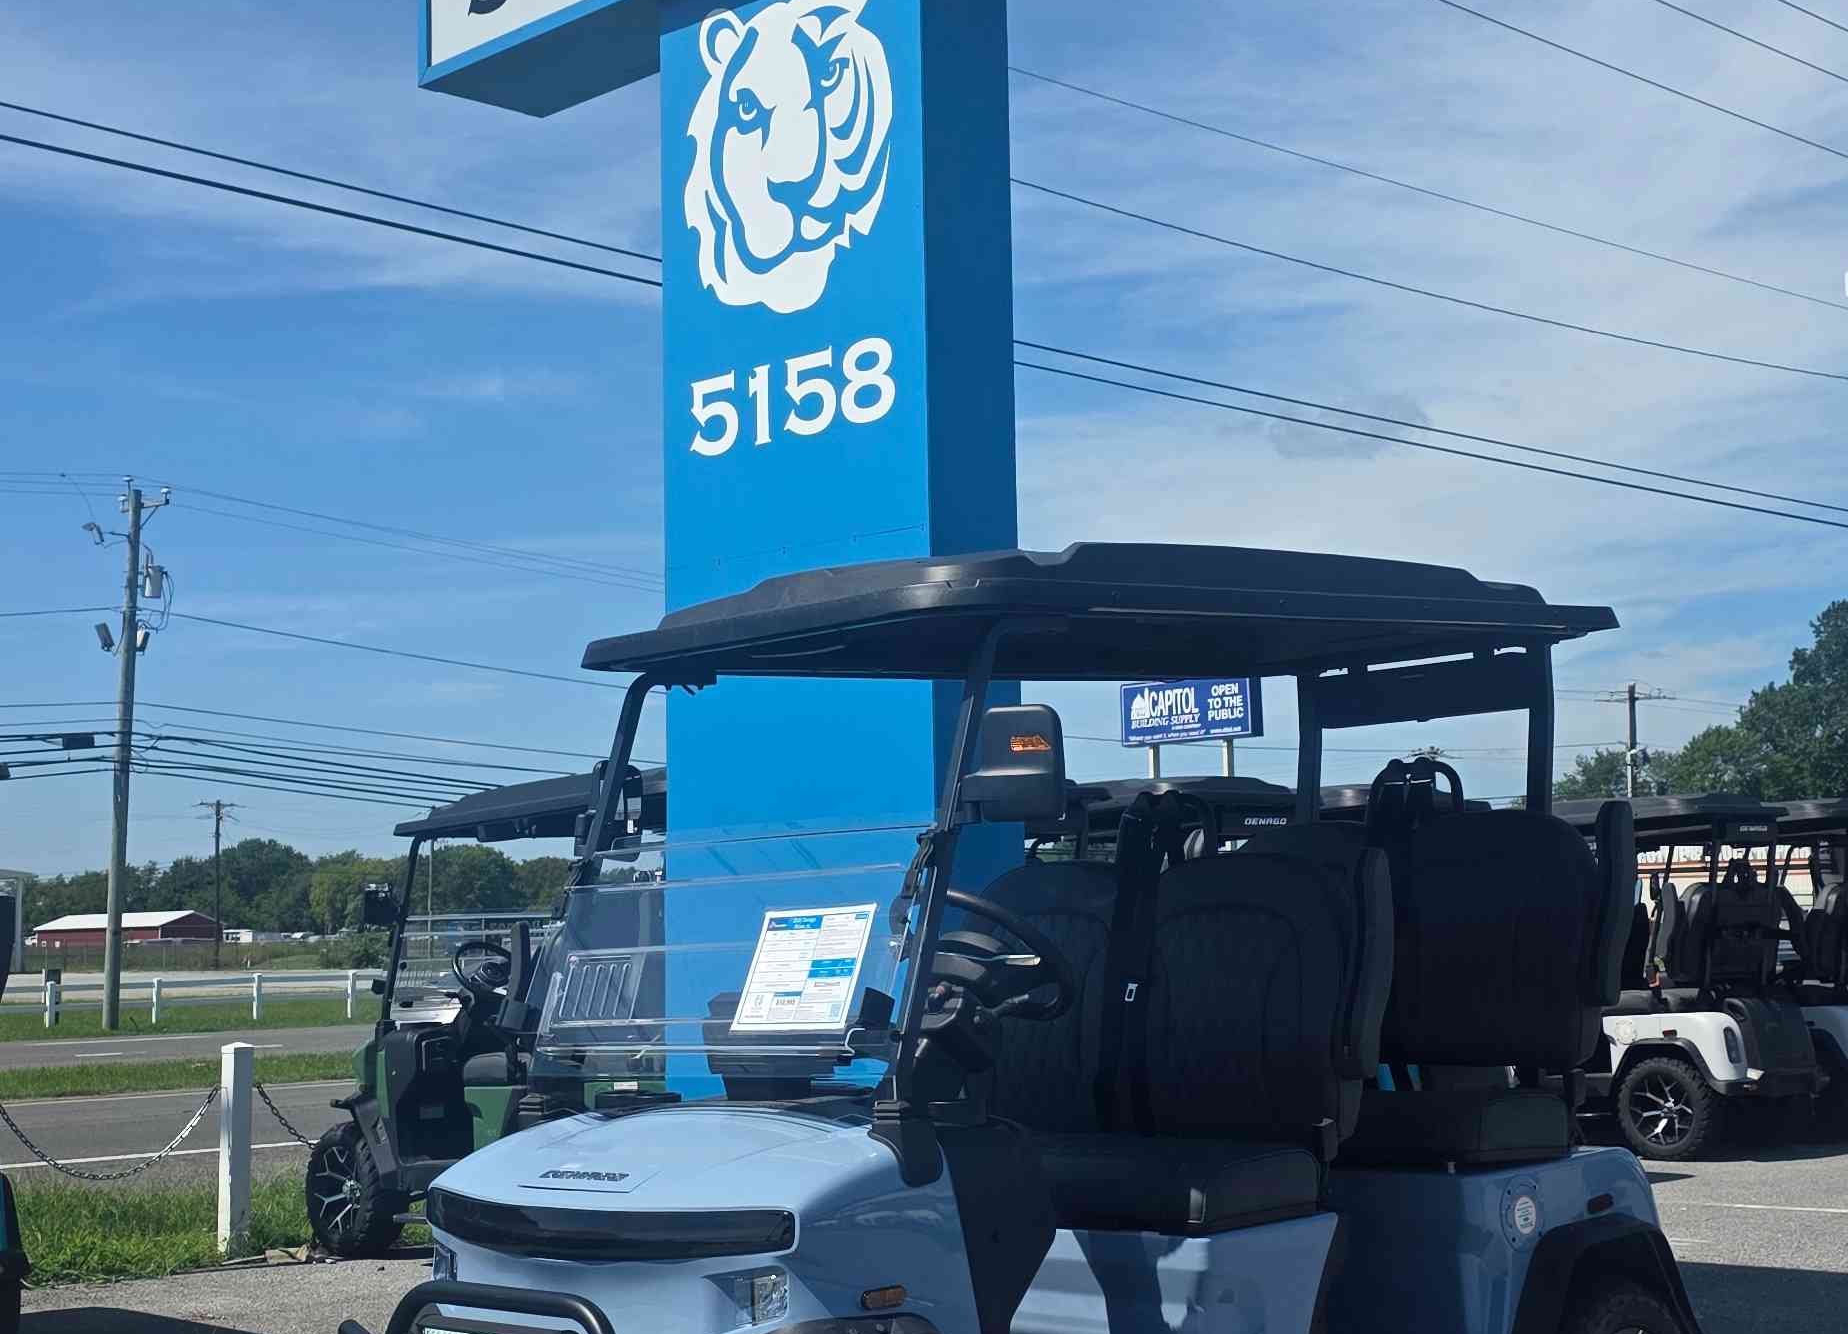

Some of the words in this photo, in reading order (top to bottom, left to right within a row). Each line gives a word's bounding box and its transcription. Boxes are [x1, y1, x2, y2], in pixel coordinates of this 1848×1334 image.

[690, 336, 896, 456] 5158
[1211, 682, 1239, 696] OPEN
[1149, 686, 1200, 717] CAPITOL
[1207, 698, 1221, 709] TO
[1222, 695, 1244, 708] THE
[1131, 717, 1170, 729] BUILDING
[1170, 713, 1201, 725] SUPPLY
[1207, 707, 1245, 721] PUBLIC
